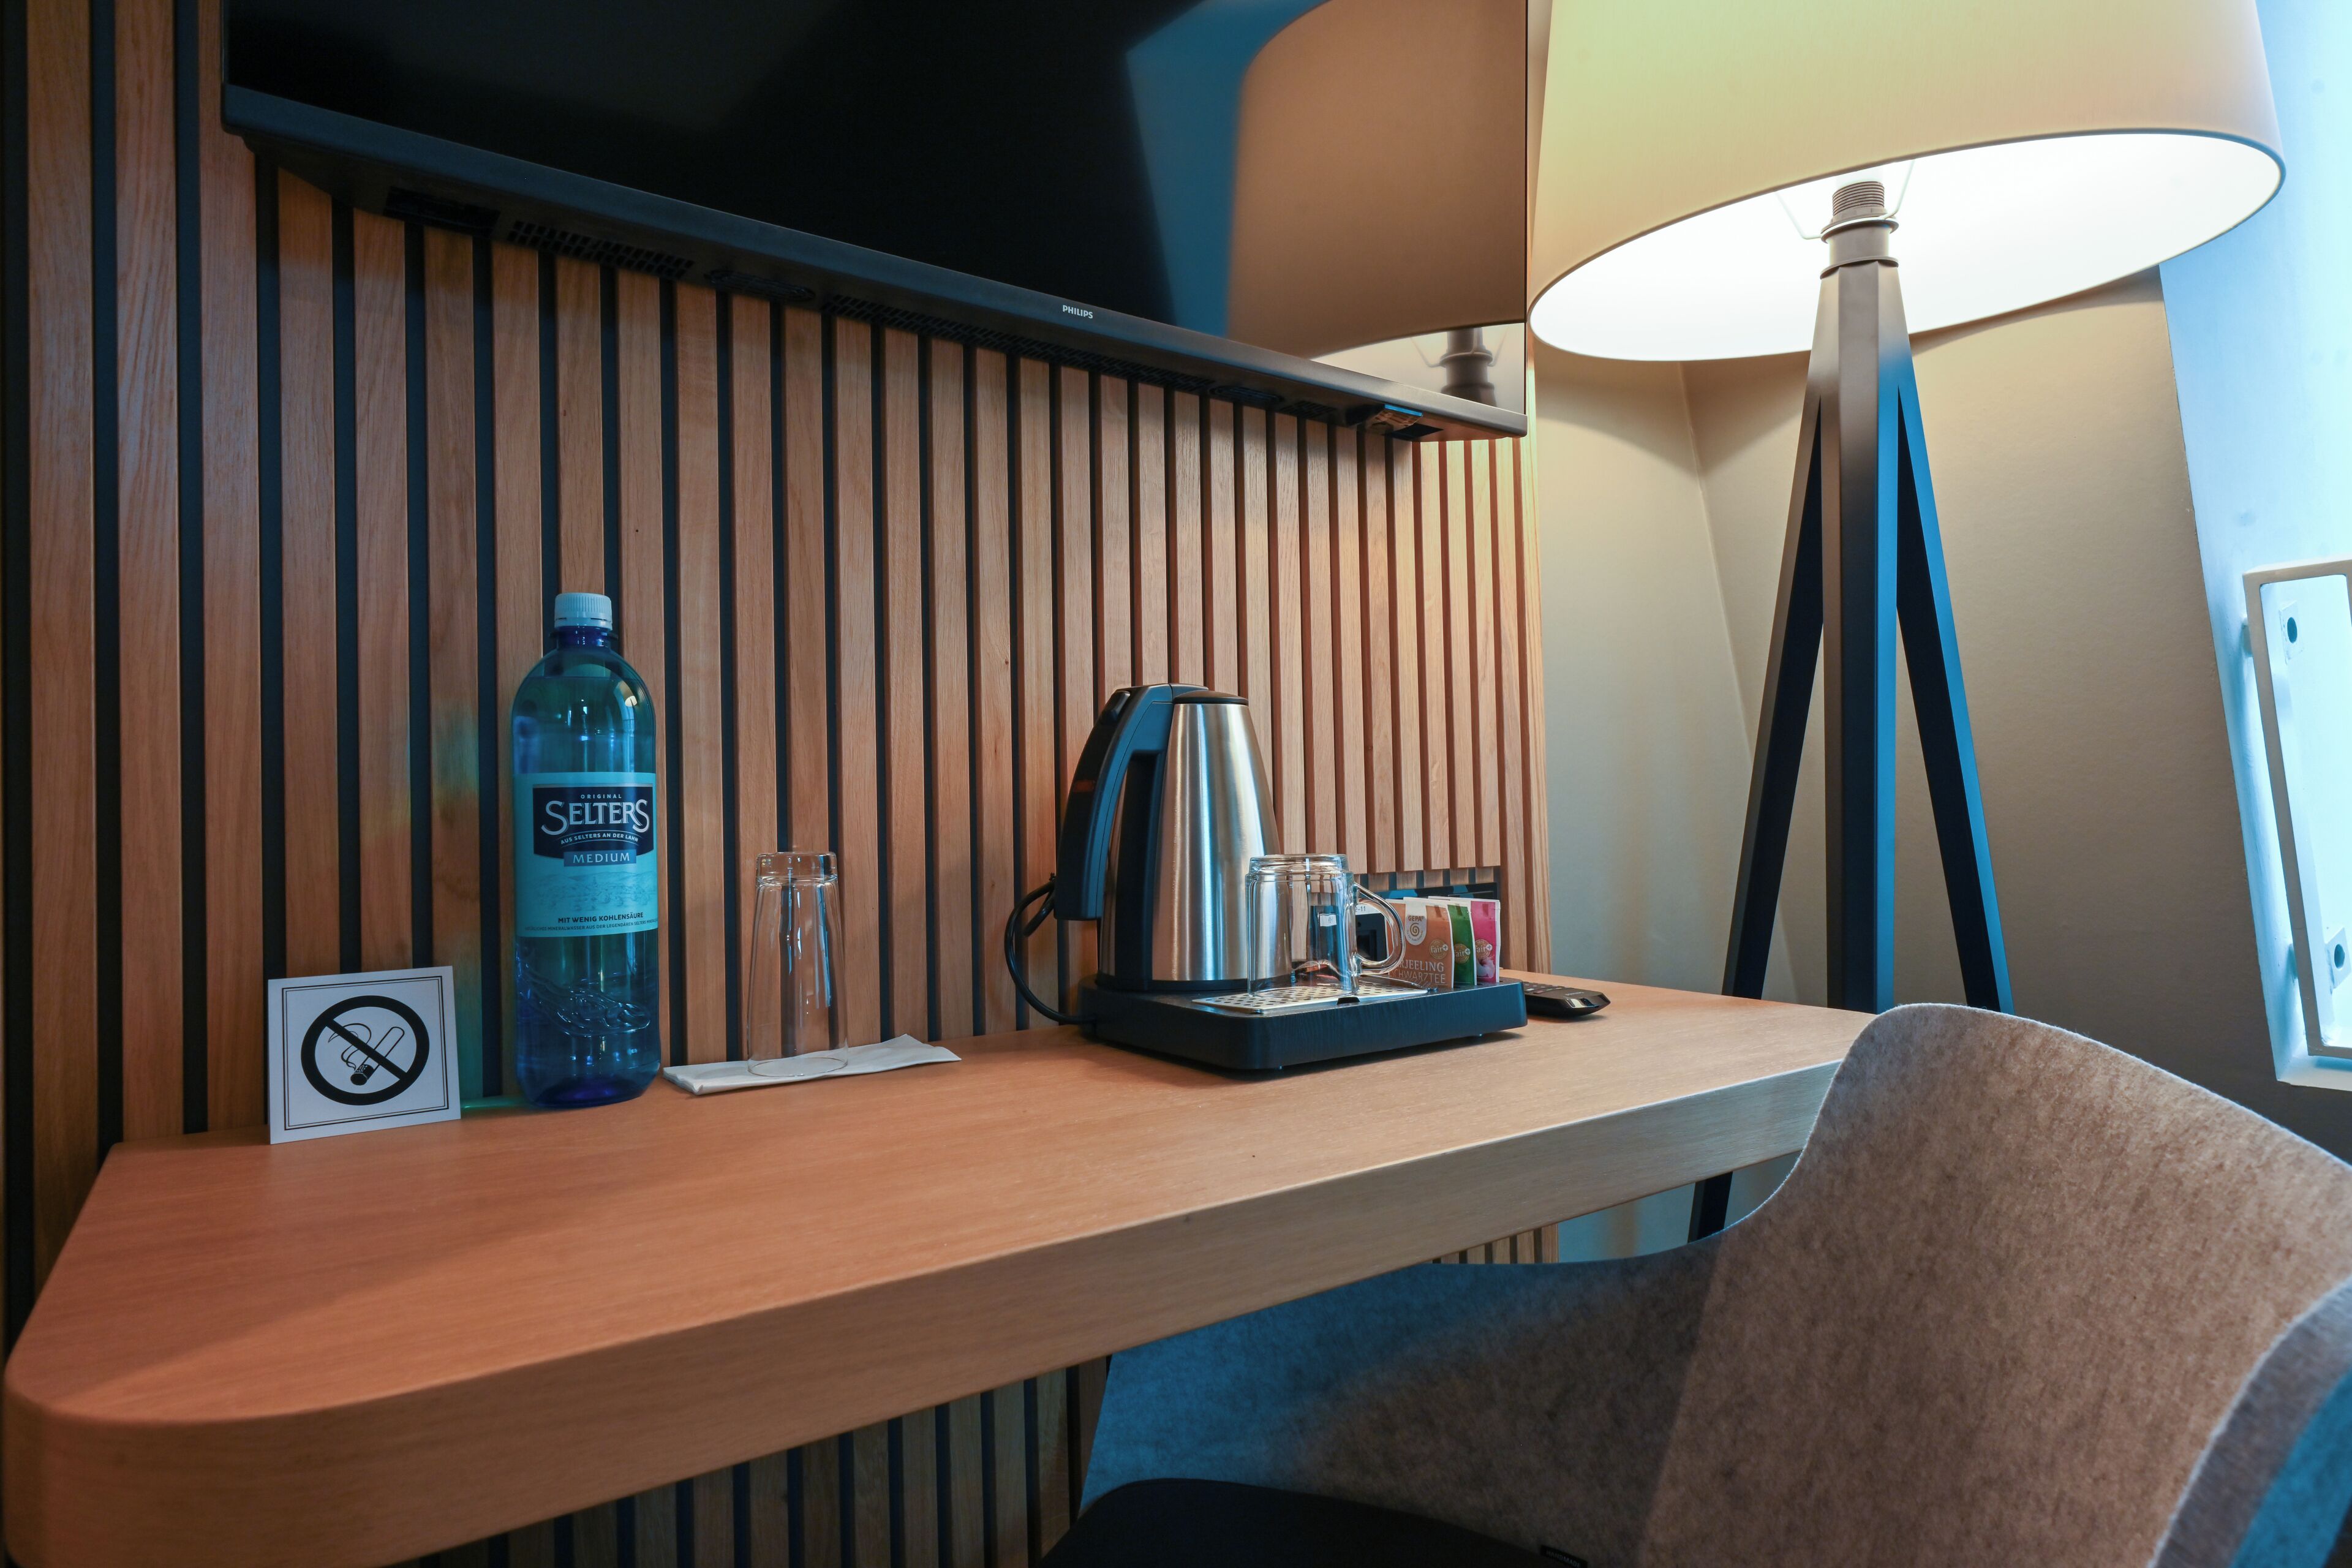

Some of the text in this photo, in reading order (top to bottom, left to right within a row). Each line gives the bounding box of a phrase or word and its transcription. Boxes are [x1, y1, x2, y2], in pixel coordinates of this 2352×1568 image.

[1062, 304, 1093, 319] PHILIPS
[541, 799, 650, 835] SELTERS
[573, 852, 630, 864] MEDIUM
[599, 912, 644, 922] KOHLENSÄURE
